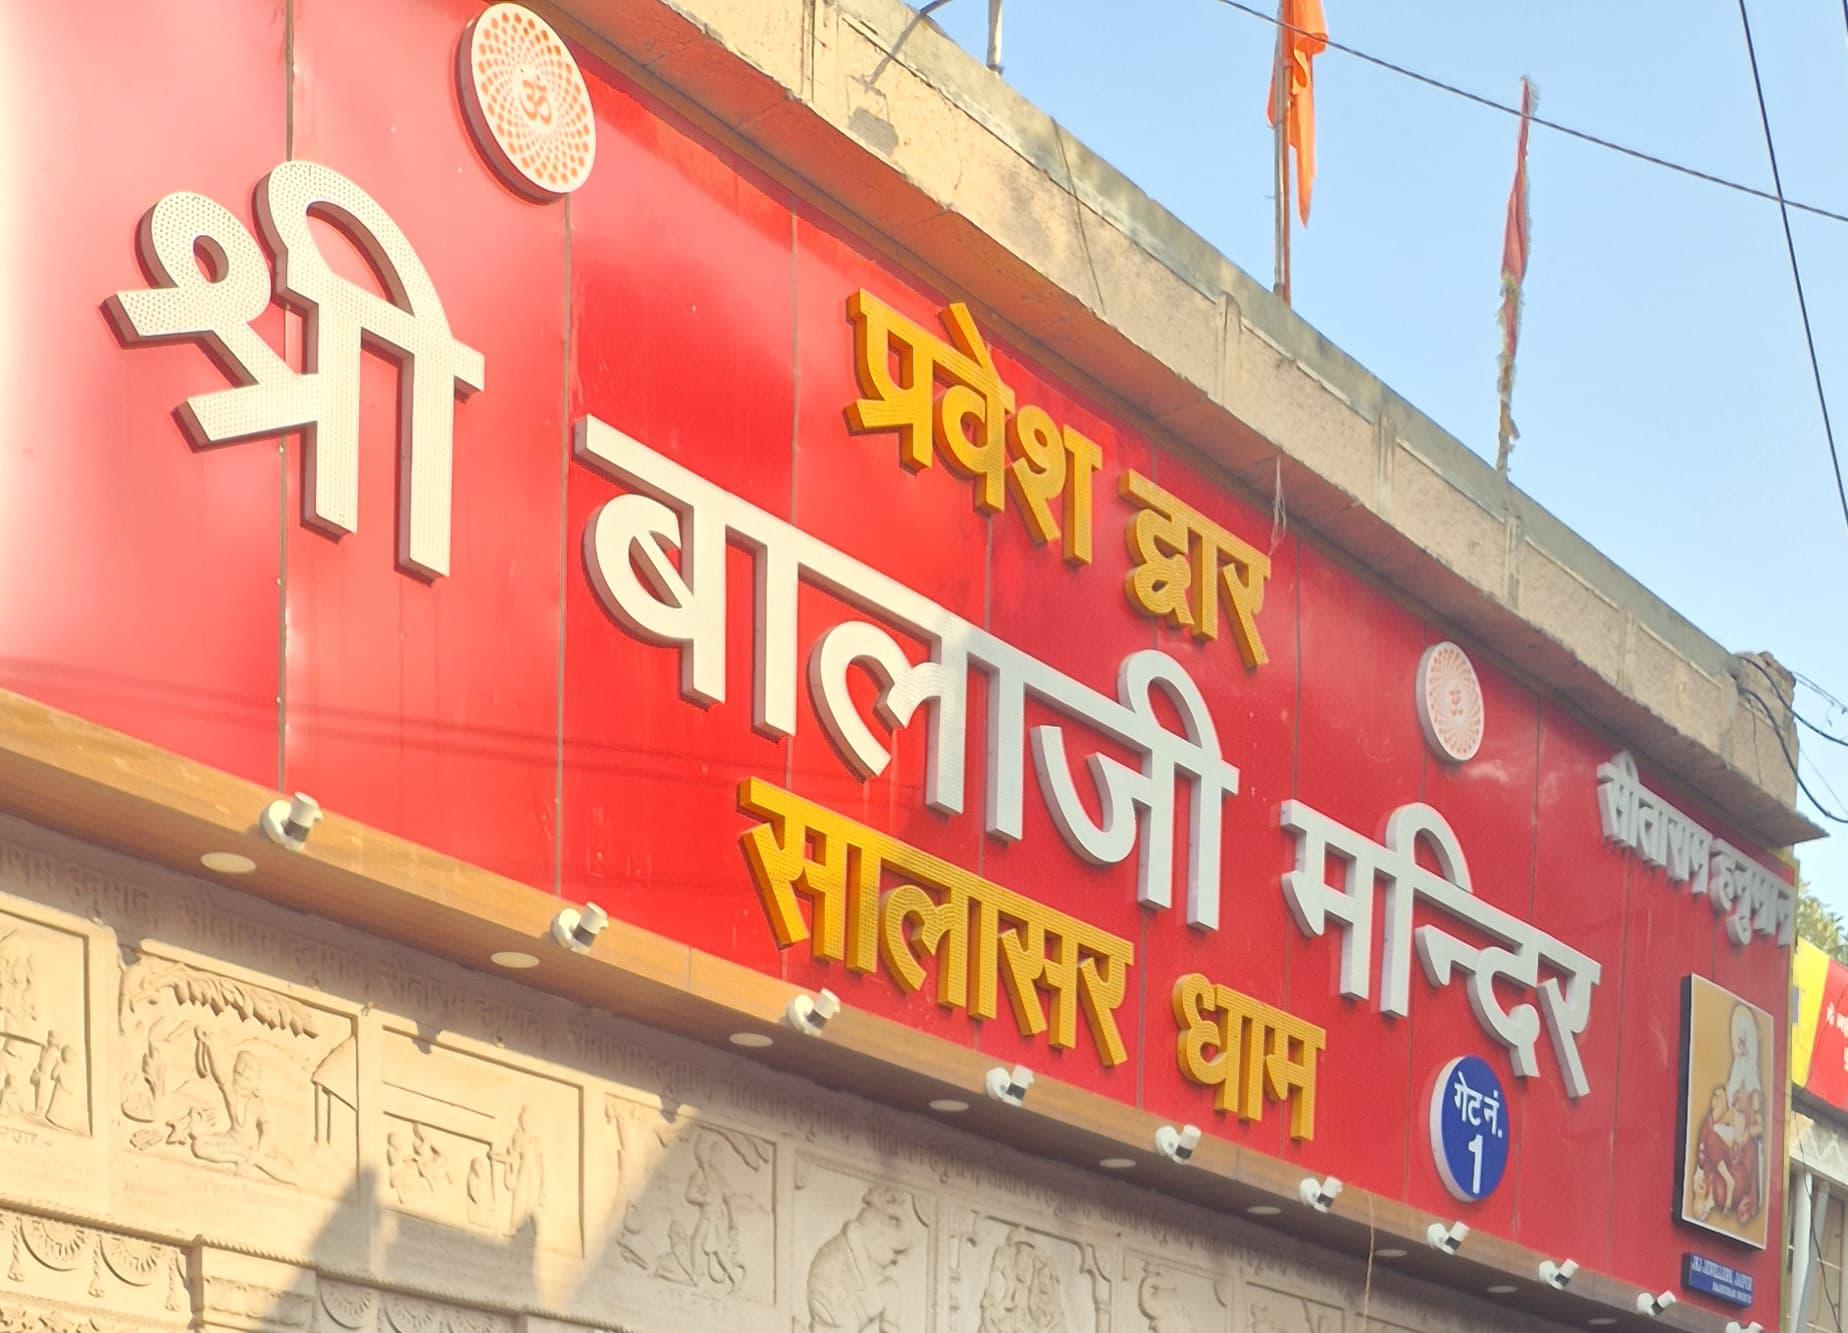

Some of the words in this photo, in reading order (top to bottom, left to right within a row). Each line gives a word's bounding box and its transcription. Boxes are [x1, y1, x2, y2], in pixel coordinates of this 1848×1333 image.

[843, 288, 1102, 566] प्रवेश
[1119, 469, 1271, 669] द्वार
[101, 160, 485, 583] श्री
[574, 415, 1239, 931] बालाजी
[1280, 801, 1600, 1098] मन्दिर
[739, 776, 1134, 1067] सालासर
[1174, 973, 1325, 1141] धाम
[1597, 749, 1713, 897] सीताराम
[1709, 838, 1796, 949] हनुमान
[1454, 1071, 1483, 1126] गेट
[1468, 1133, 1483, 1194] 1
